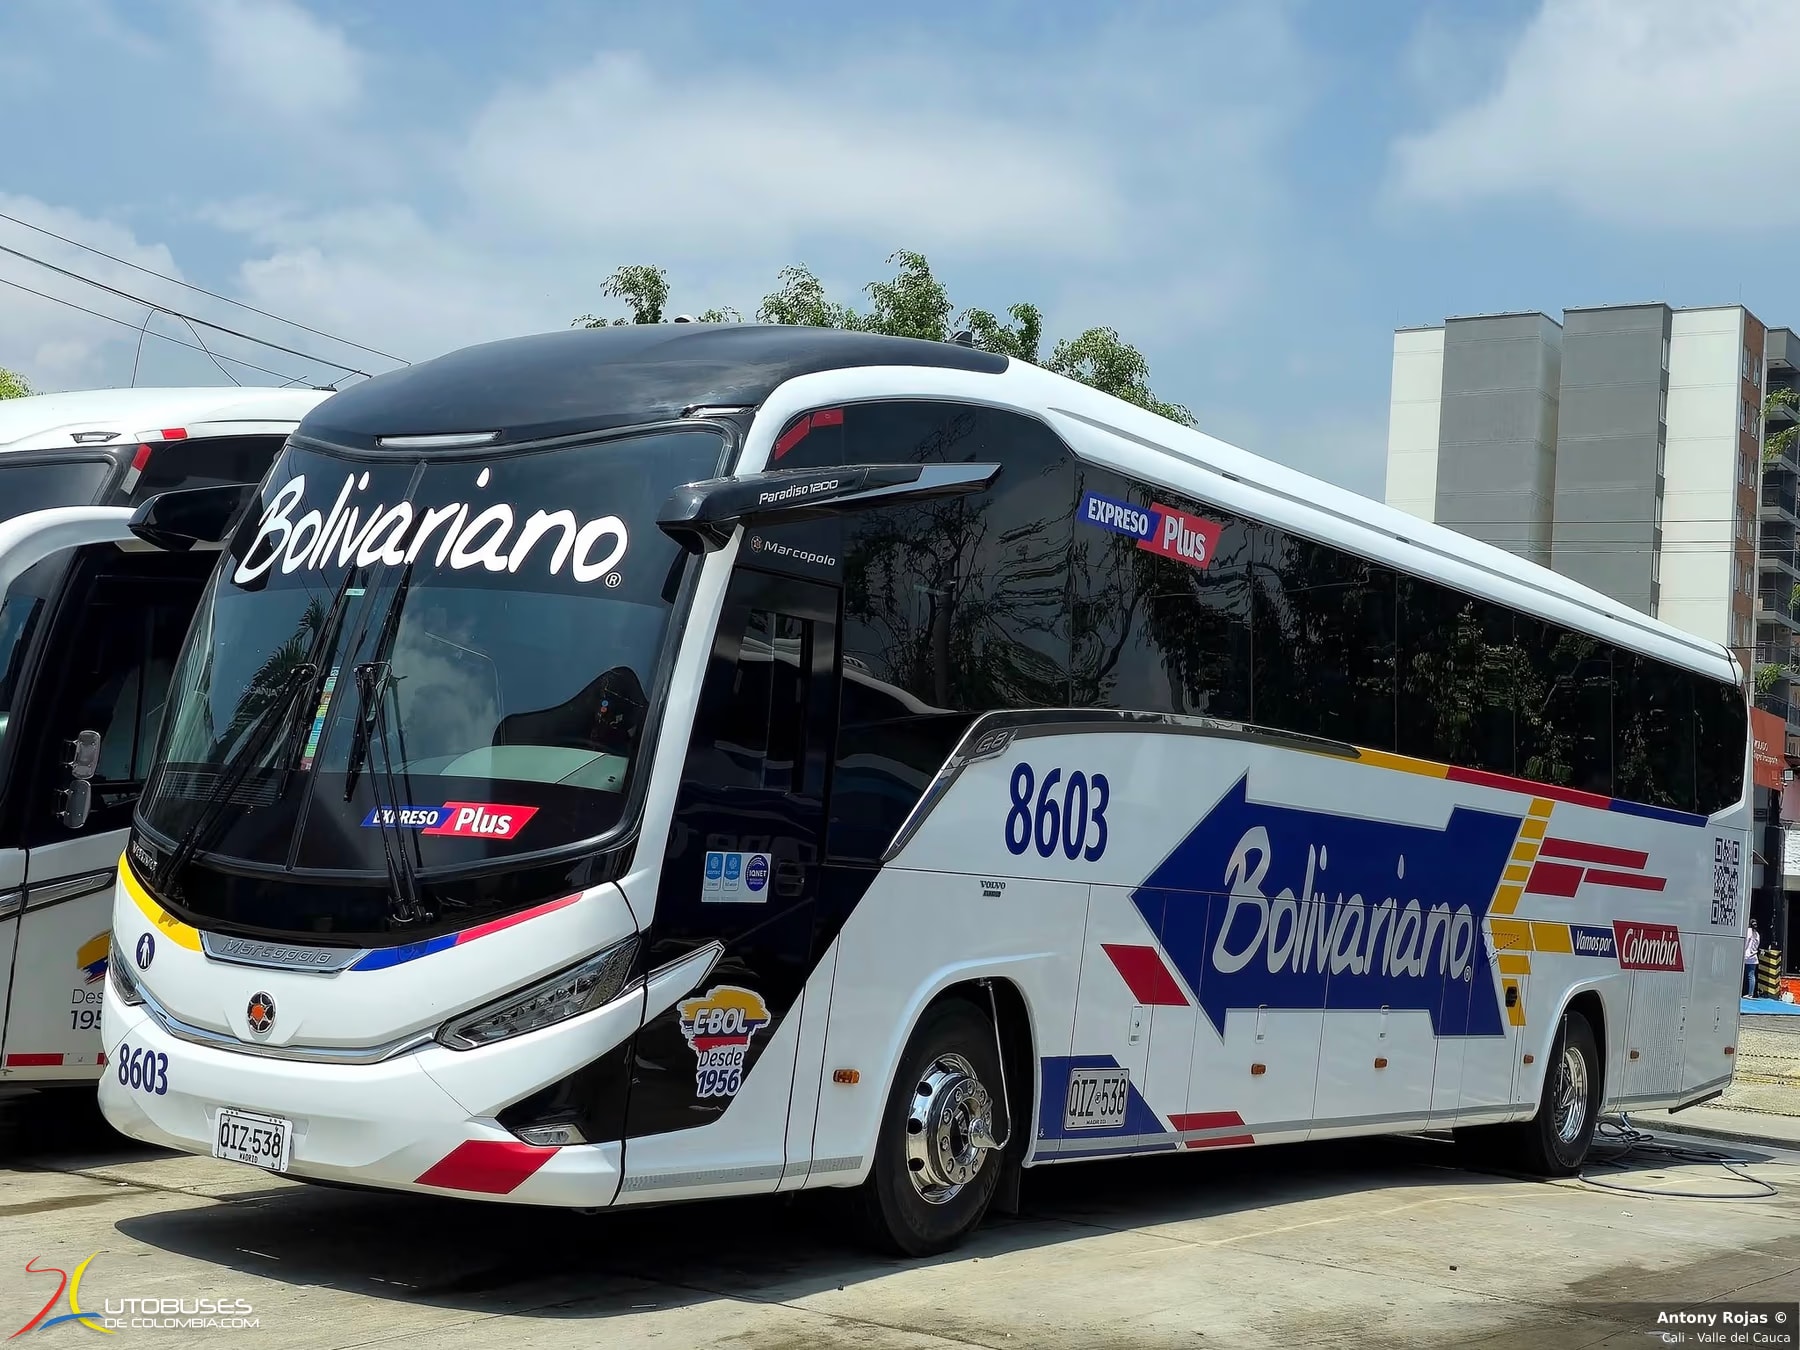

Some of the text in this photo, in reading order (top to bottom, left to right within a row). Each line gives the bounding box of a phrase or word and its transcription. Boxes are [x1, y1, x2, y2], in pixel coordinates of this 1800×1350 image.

[759, 480, 838, 504] Paradiso 1200
[233, 467, 628, 584] Bolivariano
[1087, 497, 1206, 561] EXPRESO Plus
[763, 541, 836, 566] Marcopolo
[455, 807, 512, 835] Plus
[1005, 762, 1110, 862] 8603
[980, 880, 1006, 889] VOLVO
[1212, 825, 1473, 980] Bolivariano
[220, 940, 332, 964] Marcopolo
[1576, 930, 1612, 956] Vamos por
[1622, 928, 1679, 965] Colombia
[72, 988, 103, 1004] Des
[70, 1009, 102, 1030] 195
[118, 1043, 168, 1096] 8603
[699, 1047, 742, 1067] Desde
[698, 1069, 739, 1094] 1956
